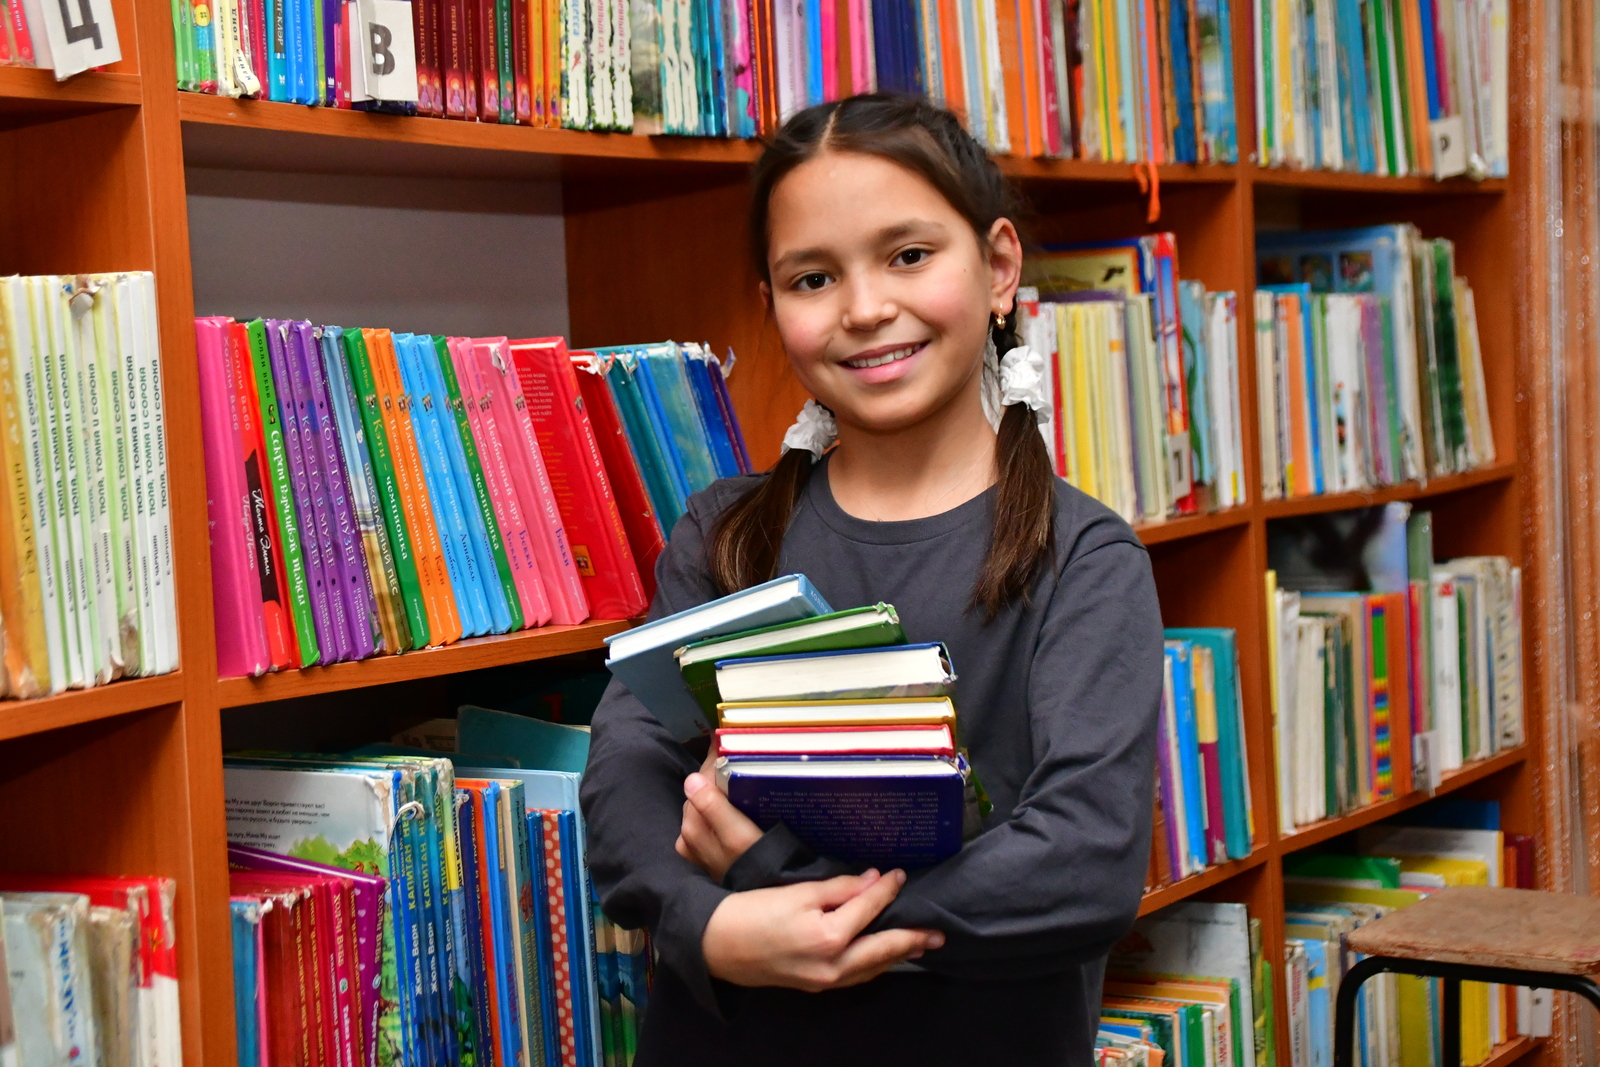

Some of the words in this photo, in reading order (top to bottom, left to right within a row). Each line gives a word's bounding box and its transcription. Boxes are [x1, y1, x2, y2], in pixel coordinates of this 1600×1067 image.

[58, 0, 103, 50] Ц
[368, 22, 395, 75] В
[24, 372, 36, 429] СОРОКА
[43, 355, 54, 410] СОРОКА
[59, 354, 70, 408] СОРОКА
[88, 363, 99, 415] СОРОКА
[111, 371, 121, 423] СОРОКА
[126, 355, 136, 410] СОРОКА
[139, 367, 149, 418] СОРОКА
[152, 359, 161, 410] СОРОКА
[240, 395, 251, 431] Вебб
[32, 441, 42, 485] ТОМКА
[50, 427, 61, 472] ТОМКА
[66, 426, 76, 471] ТОМКА
[93, 430, 104, 473] ТОМКА
[116, 437, 126, 479] ТОМКА
[131, 426, 140, 470] ТОМКА
[144, 433, 153, 475] ТОМКА
[156, 425, 165, 467] ТОМКА
[302, 498, 310, 508] В
[316, 497, 325, 507] В
[372, 419, 390, 458] Кэти
[385, 476, 408, 560] чемпионка
[403, 419, 424, 490] Идеальный
[420, 494, 439, 552] праздник
[434, 554, 446, 586] Кэти
[460, 420, 474, 457] Кэти
[474, 472, 500, 551] чемпионка
[486, 418, 512, 496] Необычный
[508, 499, 522, 526] друг
[518, 529, 534, 569] Бекки
[521, 417, 548, 495] Необычный
[545, 498, 558, 525] друг
[554, 528, 571, 567] Бекки
[595, 470, 610, 499] роль
[305, 513, 322, 570] МУЗЕЕ
[319, 512, 335, 569] МУЗЕЕ
[336, 495, 344, 506] В
[340, 511, 356, 567] МУЗЕЕ
[364, 462, 392, 565] ШОКОЛАДНЫЙ
[386, 568, 399, 596] ПЁС
[459, 533, 476, 582] Аннабель
[401, 811, 410, 838] НЕМ
[451, 806, 461, 861] КАПИТАНА
[404, 844, 416, 910] КАПИТАН
[420, 843, 432, 908] КАПИТАН
[439, 836, 449, 905] КАПИТАН
[410, 923, 420, 957] Верн
[426, 921, 436, 955] Верн
[444, 918, 453, 952] Верн
[413, 957, 423, 996] Жюль
[430, 955, 438, 994] Жюль
[447, 952, 455, 991] Жюль
